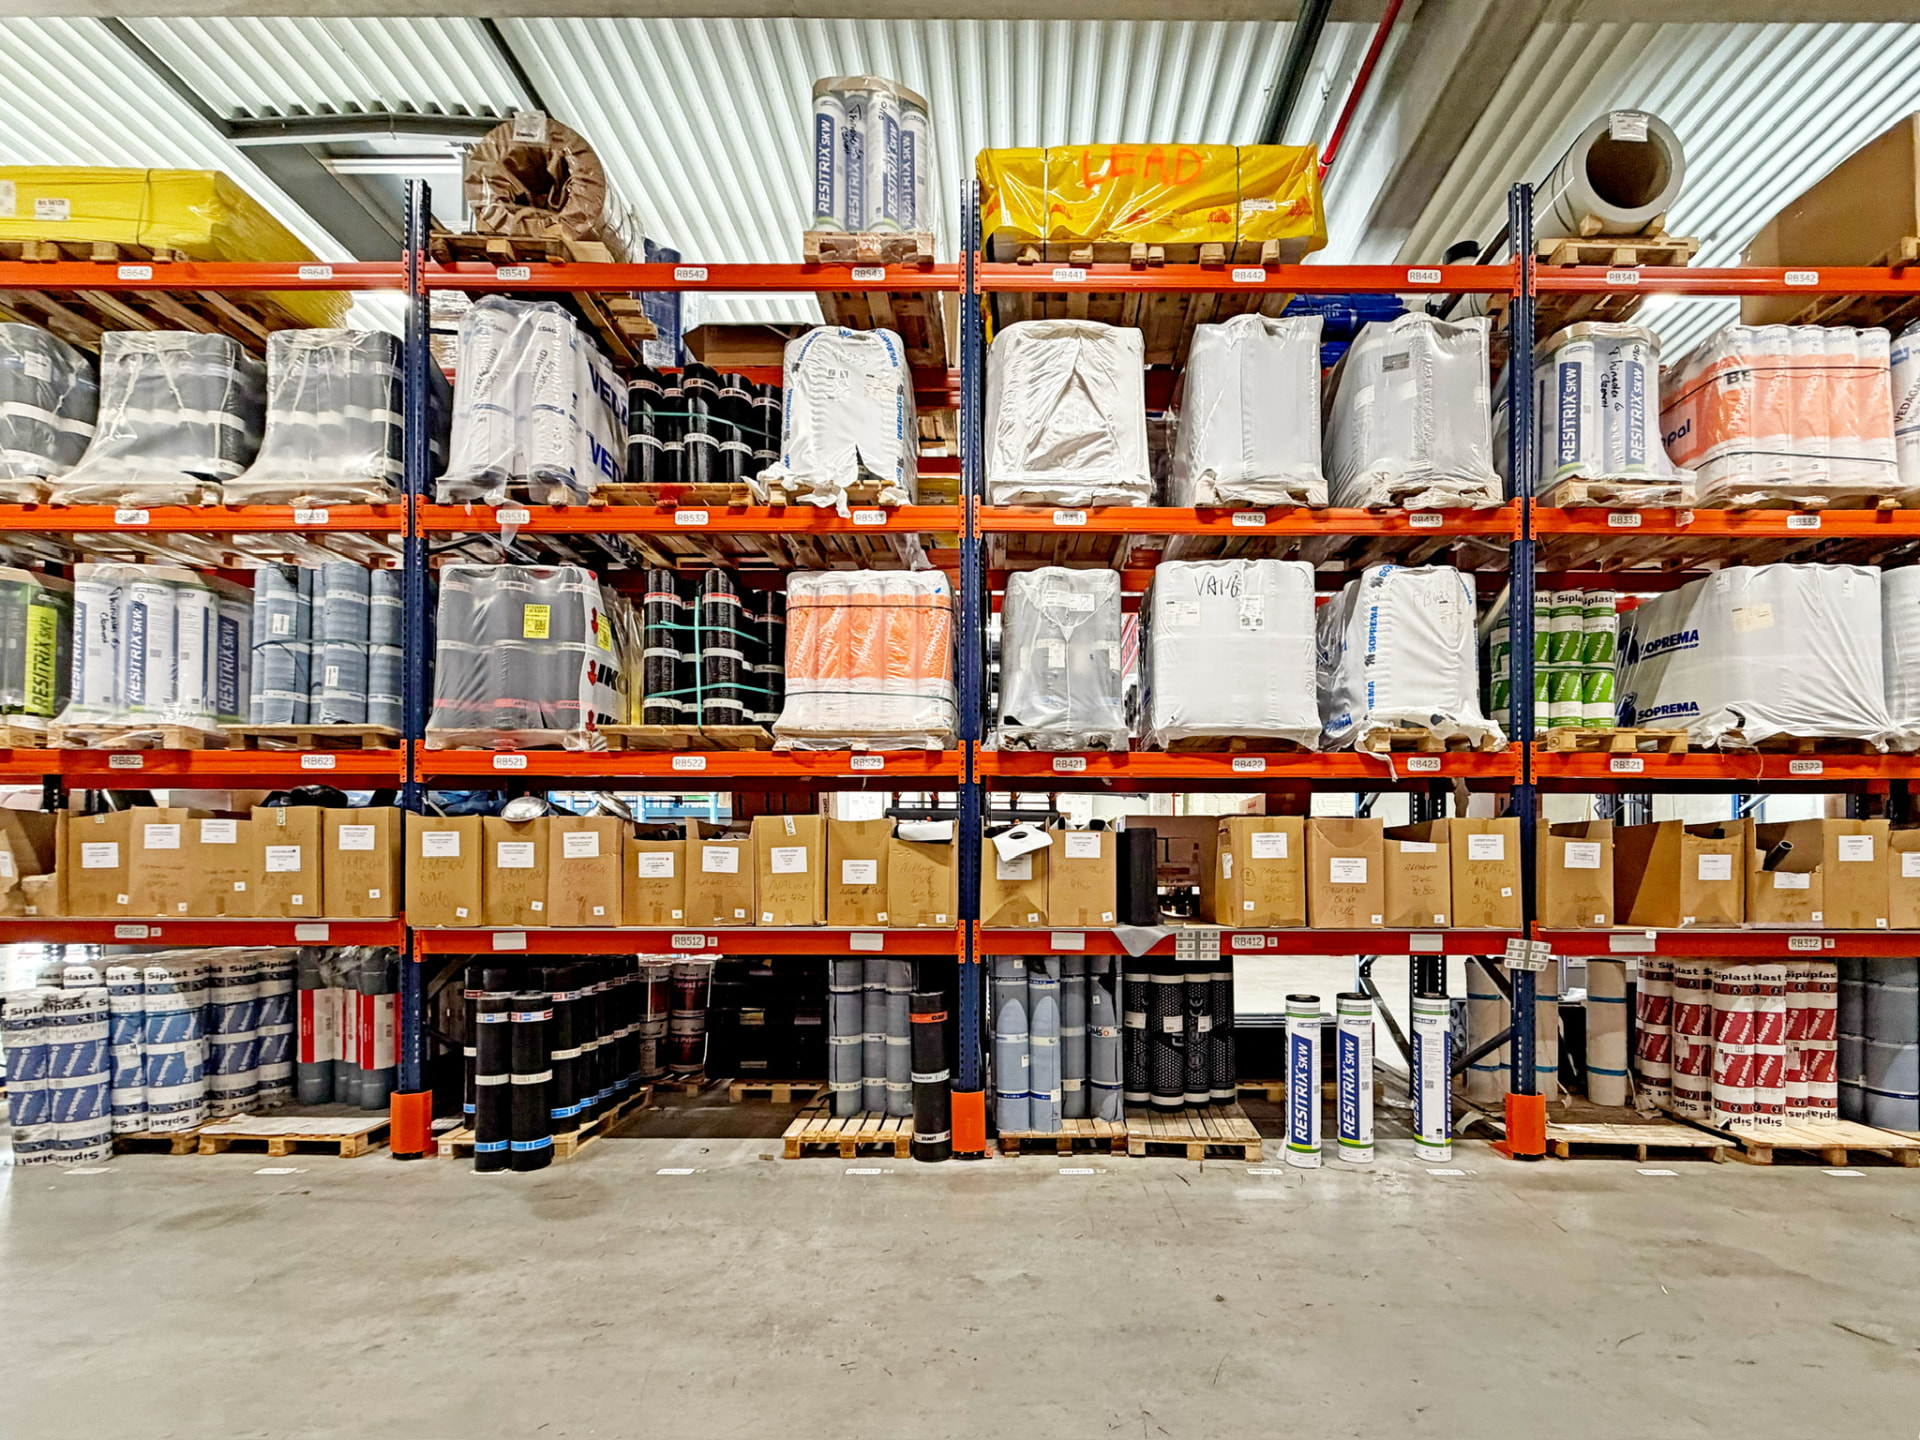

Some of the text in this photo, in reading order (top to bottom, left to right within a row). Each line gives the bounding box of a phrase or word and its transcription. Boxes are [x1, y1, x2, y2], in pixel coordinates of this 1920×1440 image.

[818, 119, 831, 214] RESITRIX SKW
[1083, 146, 1202, 190] LEAD
[886, 147, 899, 219] RESITRIX
[848, 162, 860, 228] RESITRIX
[499, 269, 528, 278] RB541
[677, 270, 706, 278] RB542
[855, 270, 883, 278] RB543
[1235, 271, 1264, 280] RB442
[1411, 272, 1439, 280] RB443
[1609, 273, 1639, 282] RB341
[1788, 274, 1817, 283] RB342
[875, 328, 899, 367] SOPREMA
[896, 396, 904, 440] SOPREMA
[1561, 367, 1577, 461] RESITRIX SKW
[1630, 367, 1644, 461] RESITRIX SKW
[499, 512, 528, 522] RB531
[678, 513, 707, 522] RB532
[856, 513, 885, 522] RB533
[1235, 515, 1264, 524] RB432
[1413, 517, 1441, 525] RB433
[1611, 516, 1639, 524] RB331
[75, 606, 84, 636] SKW
[1368, 606, 1379, 653] SOPREMA
[130, 608, 145, 703] RESITRIX SKW
[32, 616, 50, 710] RESITRIX SKP
[219, 622, 236, 713] RESITRIX SKW
[597, 663, 629, 696] IKO
[1637, 701, 1699, 719] SOPREMA
[112, 757, 141, 766] RB622
[304, 757, 333, 766] RB623
[496, 757, 525, 766] RB521
[675, 759, 704, 767] RB522
[854, 758, 882, 767] RB523
[1056, 759, 1084, 768] RB421
[1235, 760, 1264, 769] RB422
[1410, 760, 1439, 768] RB423
[1613, 761, 1642, 770] RB321
[1793, 763, 1821, 771] RB322
[675, 936, 704, 946] RB512
[1234, 937, 1263, 946] RB412
[1791, 938, 1820, 948] RB312
[148, 969, 188, 981] Siplast
[1714, 971, 1752, 982] Siplast
[1295, 1042, 1309, 1141] RESITRIX SKW
[1342, 1039, 1355, 1136] RESITRIX SKW
